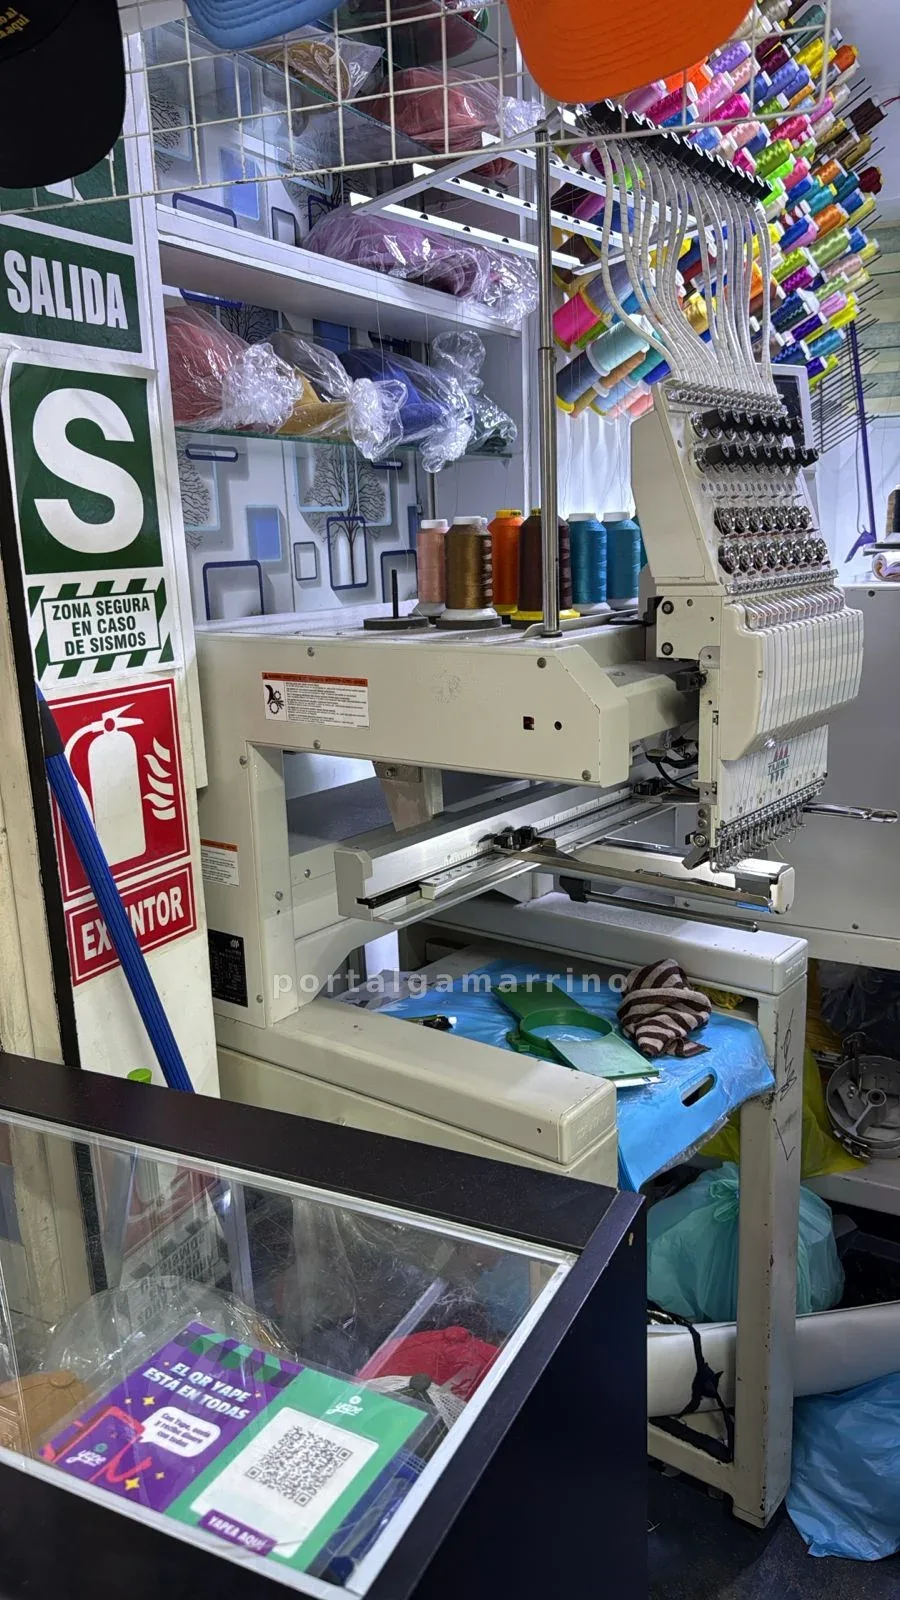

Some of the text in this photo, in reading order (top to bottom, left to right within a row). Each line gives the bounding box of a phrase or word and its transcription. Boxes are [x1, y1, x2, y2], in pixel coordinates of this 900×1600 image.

[4, 250, 128, 329] SALIDA
[33, 388, 144, 553] S
[52, 597, 150, 620] ZONA SEGURA
[72, 615, 136, 637] EN CASO
[65, 631, 146, 656] DE SISMOS
[81, 886, 184, 961] EXNTOR
[142, 1367, 250, 1420] ESTÁ EN TODAS
[170, 1362, 252, 1402] EL QR YAPE
[207, 1515, 240, 1538] YAPEA
